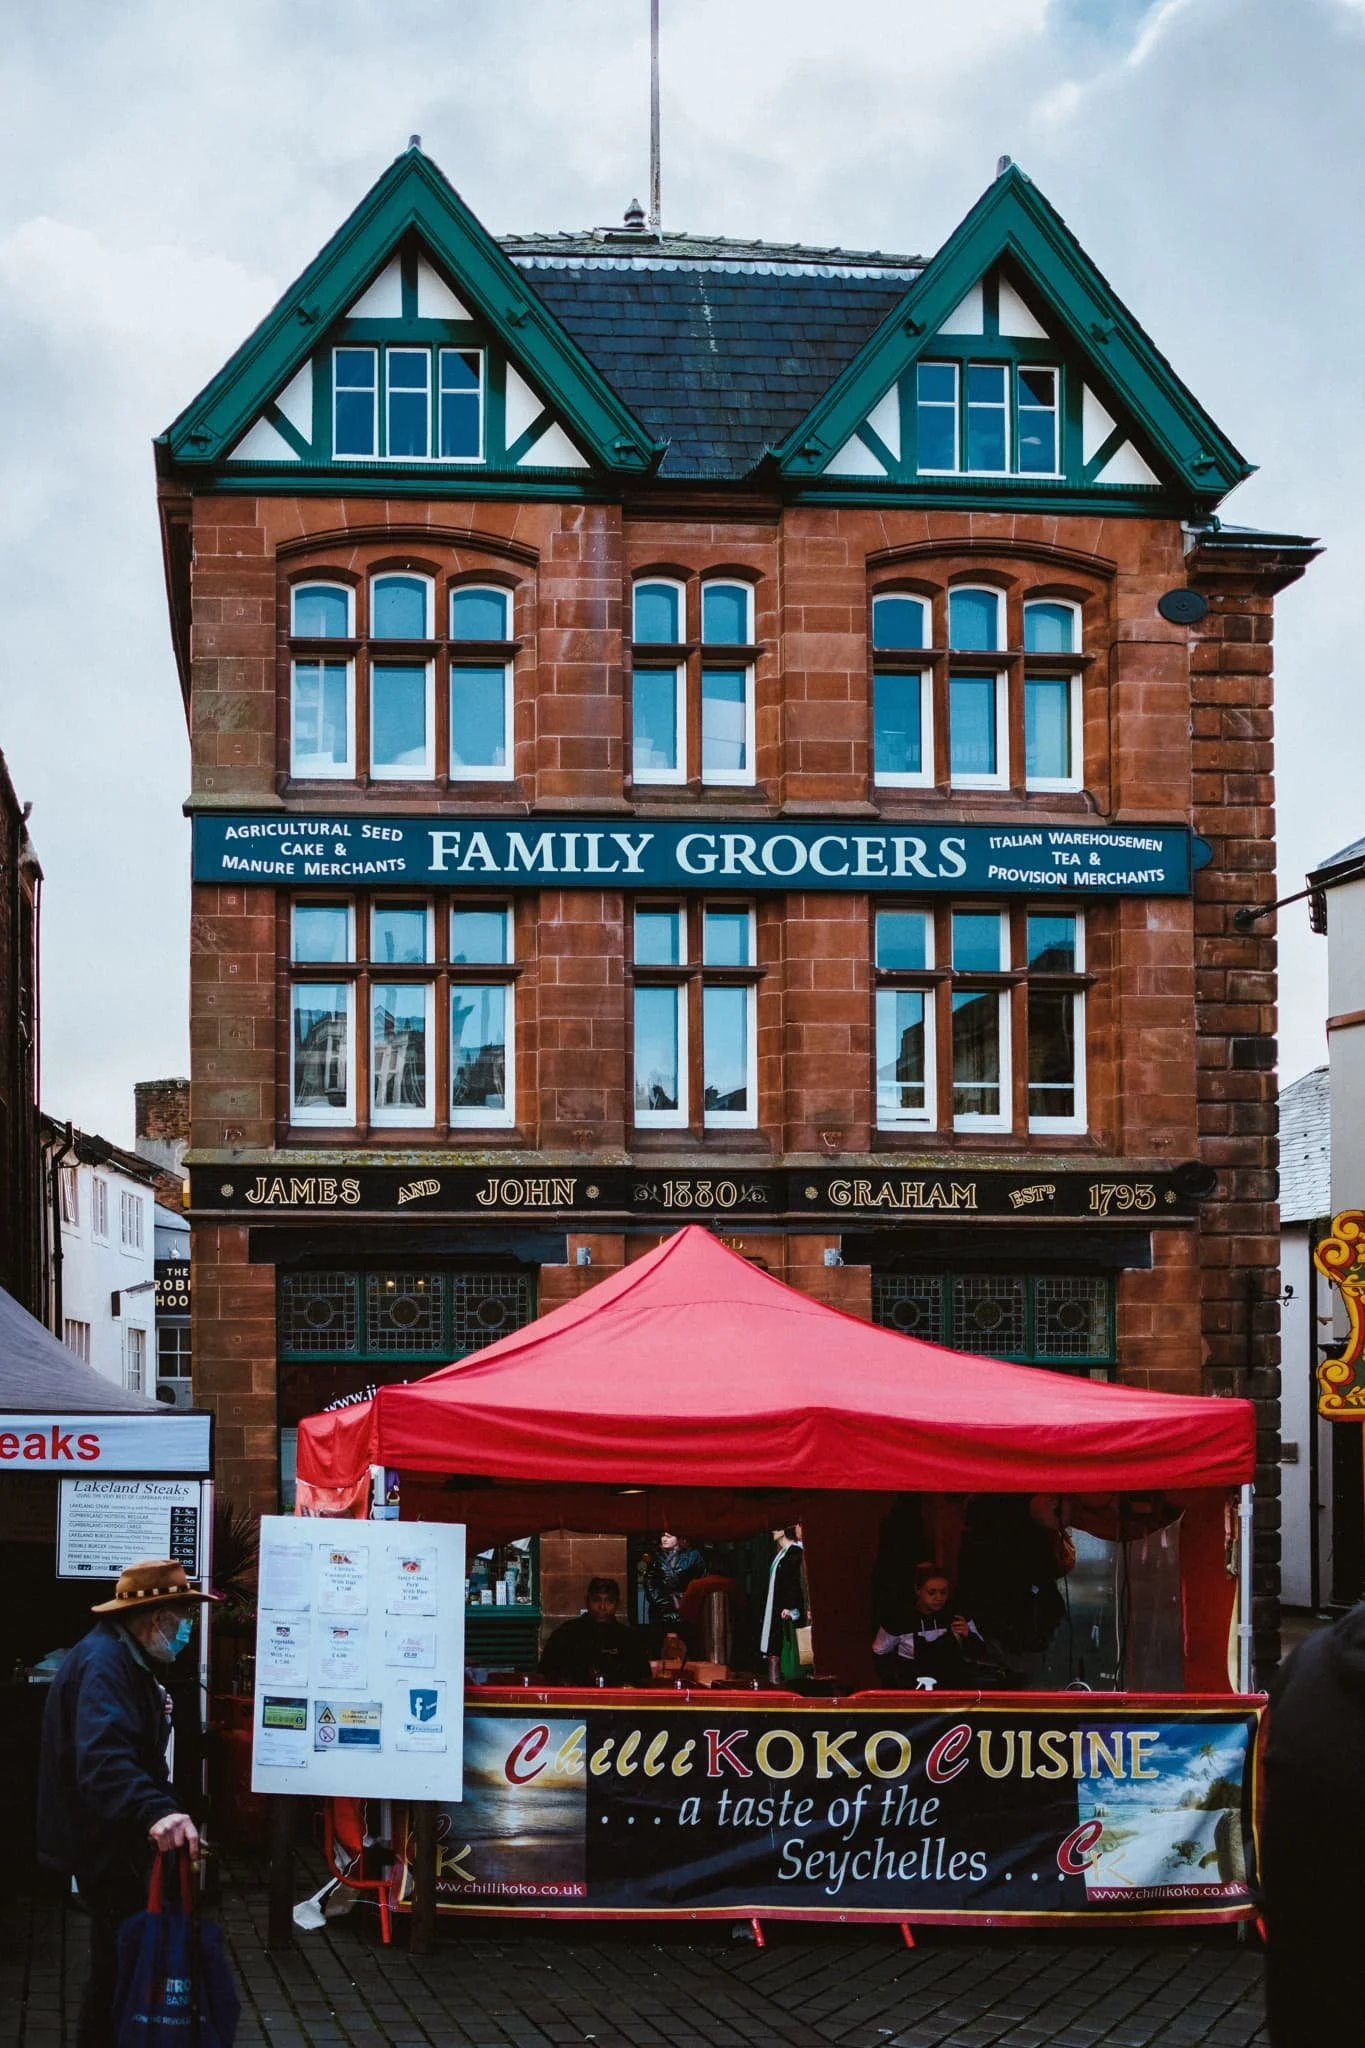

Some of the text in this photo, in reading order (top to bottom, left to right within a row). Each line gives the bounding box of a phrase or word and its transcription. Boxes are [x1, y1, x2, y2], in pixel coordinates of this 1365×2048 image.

[225, 823, 403, 842] AGRICULTURAL SEED
[989, 831, 1163, 852] ITALIAN WAREHOUSEMEN
[281, 842, 347, 856] CAKE &
[428, 831, 967, 878] FAMILY GROCERS
[1052, 851, 1101, 866] TEA &
[222, 855, 406, 876] MANURE MERCHANTS
[988, 865, 1165, 885] PROVISION MERCHANTS
[245, 1177, 361, 1205] JAMES
[397, 1179, 441, 1205] AND
[476, 1178, 577, 1206] JOHN
[663, 1181, 737, 1208] 1880
[827, 1180, 979, 1209] GRAHAM
[1089, 1184, 1156, 1215] 1793
[166, 1268, 189, 1277] THE
[73, 1481, 190, 1496] Lakeland Steaks
[926, 1723, 1160, 1784] CUISINE
[678, 1796, 702, 1827] a
[717, 1788, 814, 1827] taste
[827, 1783, 872, 1841] of
[880, 1786, 940, 1827] the
[778, 1837, 988, 1896] Seychelles
[1091, 1883, 1249, 1901] www.chillikoko.co.uk
